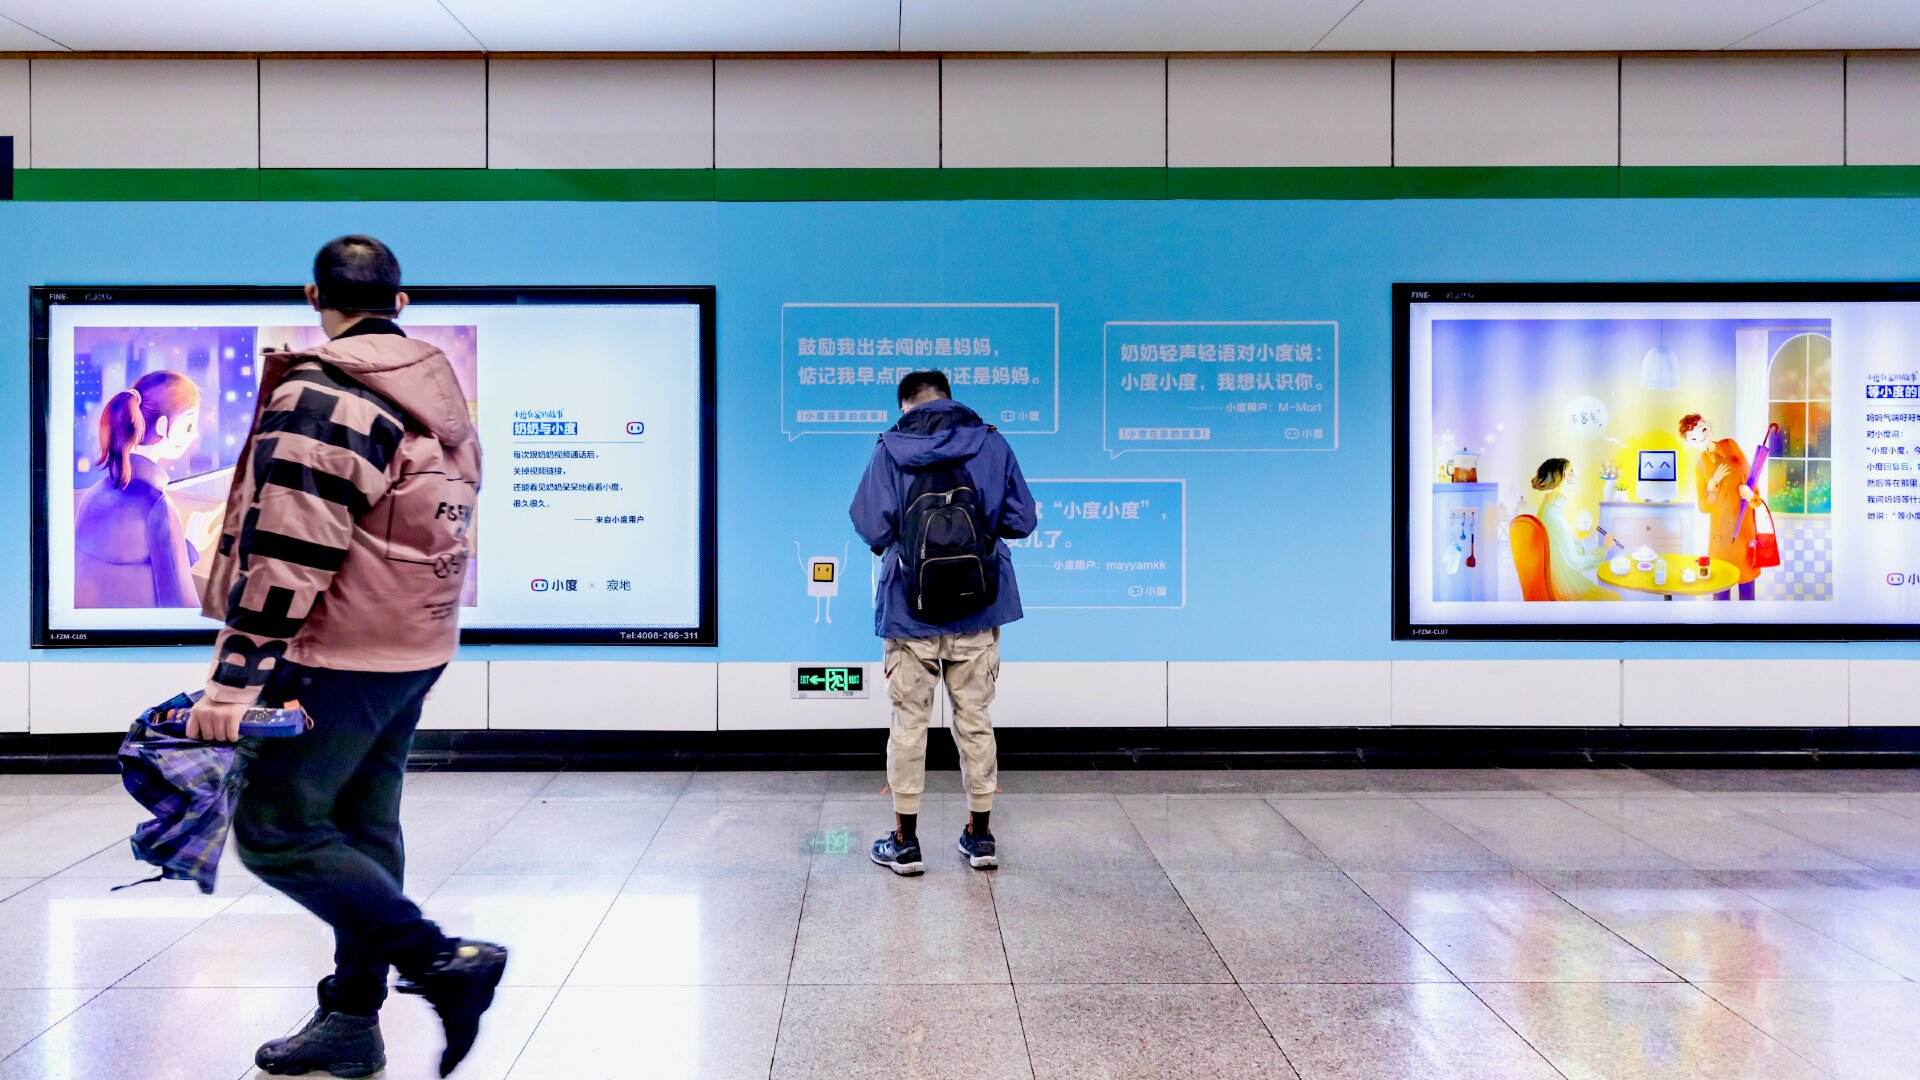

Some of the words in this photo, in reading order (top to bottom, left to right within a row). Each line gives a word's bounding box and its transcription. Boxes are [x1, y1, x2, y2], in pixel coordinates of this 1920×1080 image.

[798, 337, 999, 357] 鼓励我出去闯的是妈妈，
[1120, 343, 1322, 362] 奶奶轻声轻语对小度说：
[797, 366, 1040, 385] 惦记我早点回还是妈妈。
[1120, 372, 1323, 391] 小度小度，我想认识你。
[1868, 386, 1920, 398] 等小度的
[513, 422, 577, 436] 奶奶与小度
[1866, 462, 1920, 471] 小度回复后，
[552, 578, 578, 592] 小度
[606, 579, 632, 592] 寂地
[619, 631, 699, 640] Tel:4008-266-311
